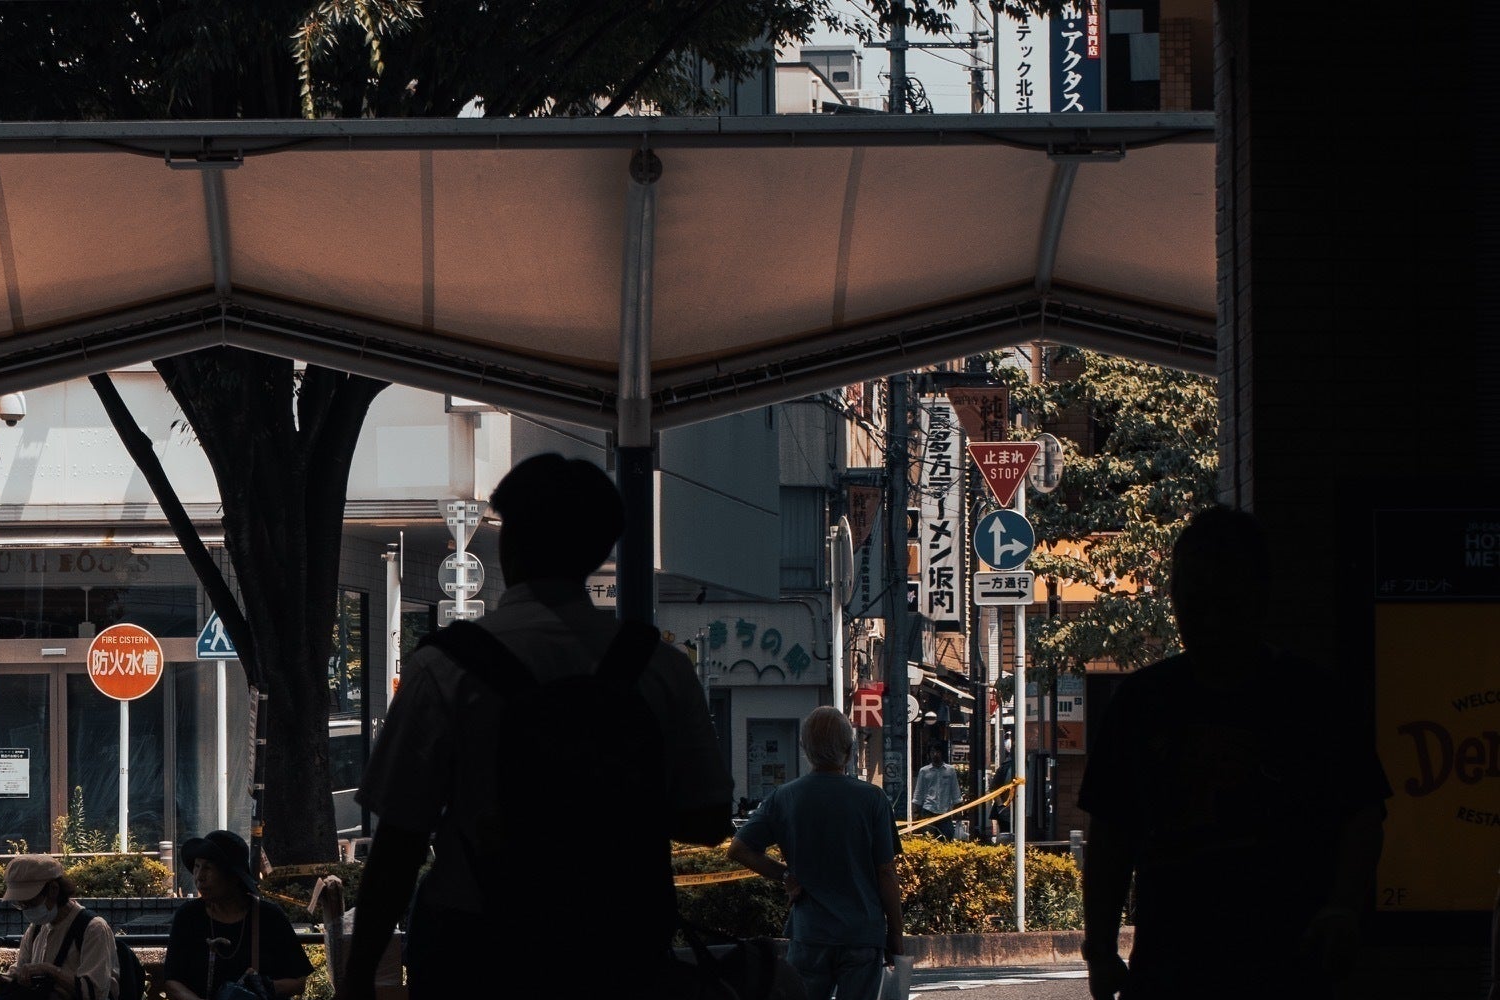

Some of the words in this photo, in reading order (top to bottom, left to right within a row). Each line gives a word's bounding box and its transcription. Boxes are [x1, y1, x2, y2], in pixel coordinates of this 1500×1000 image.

[983, 450, 1026, 465] 止まれ
[990, 467, 1019, 480] STOP
[978, 577, 1029, 590] 一方通行
[101, 636, 117, 644] FIRE
[120, 636, 149, 644] CISTERN
[92, 649, 158, 676] 防火水槽
